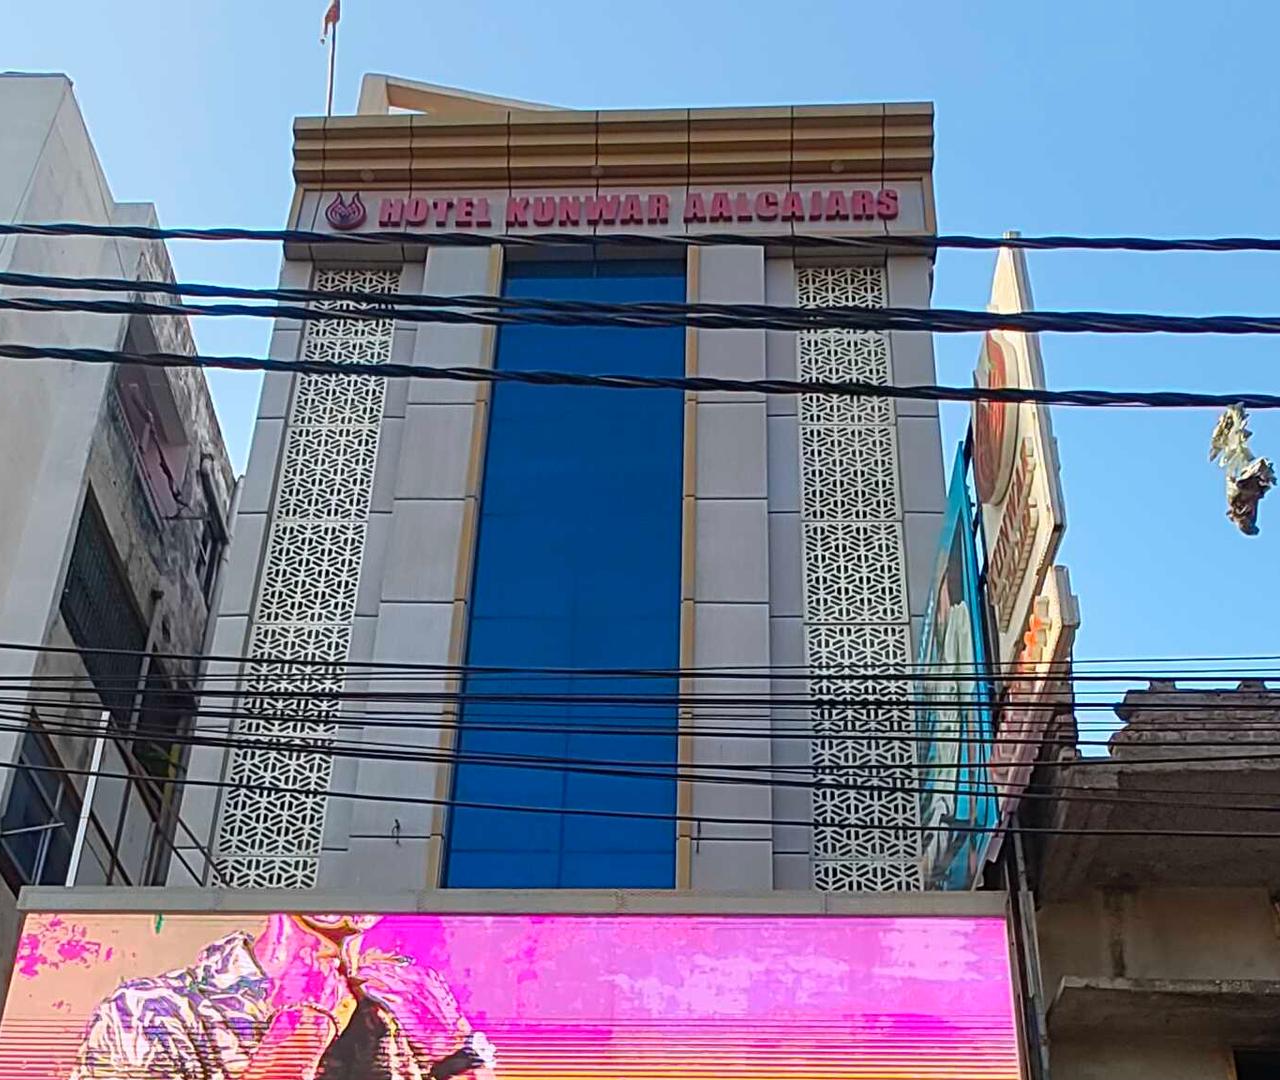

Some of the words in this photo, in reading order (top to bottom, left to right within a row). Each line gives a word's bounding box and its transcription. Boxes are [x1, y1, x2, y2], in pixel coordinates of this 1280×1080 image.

[379, 197, 493, 227] HOTEL
[505, 193, 670, 228] KUNWAR
[683, 189, 899, 224] AALCAJARS
